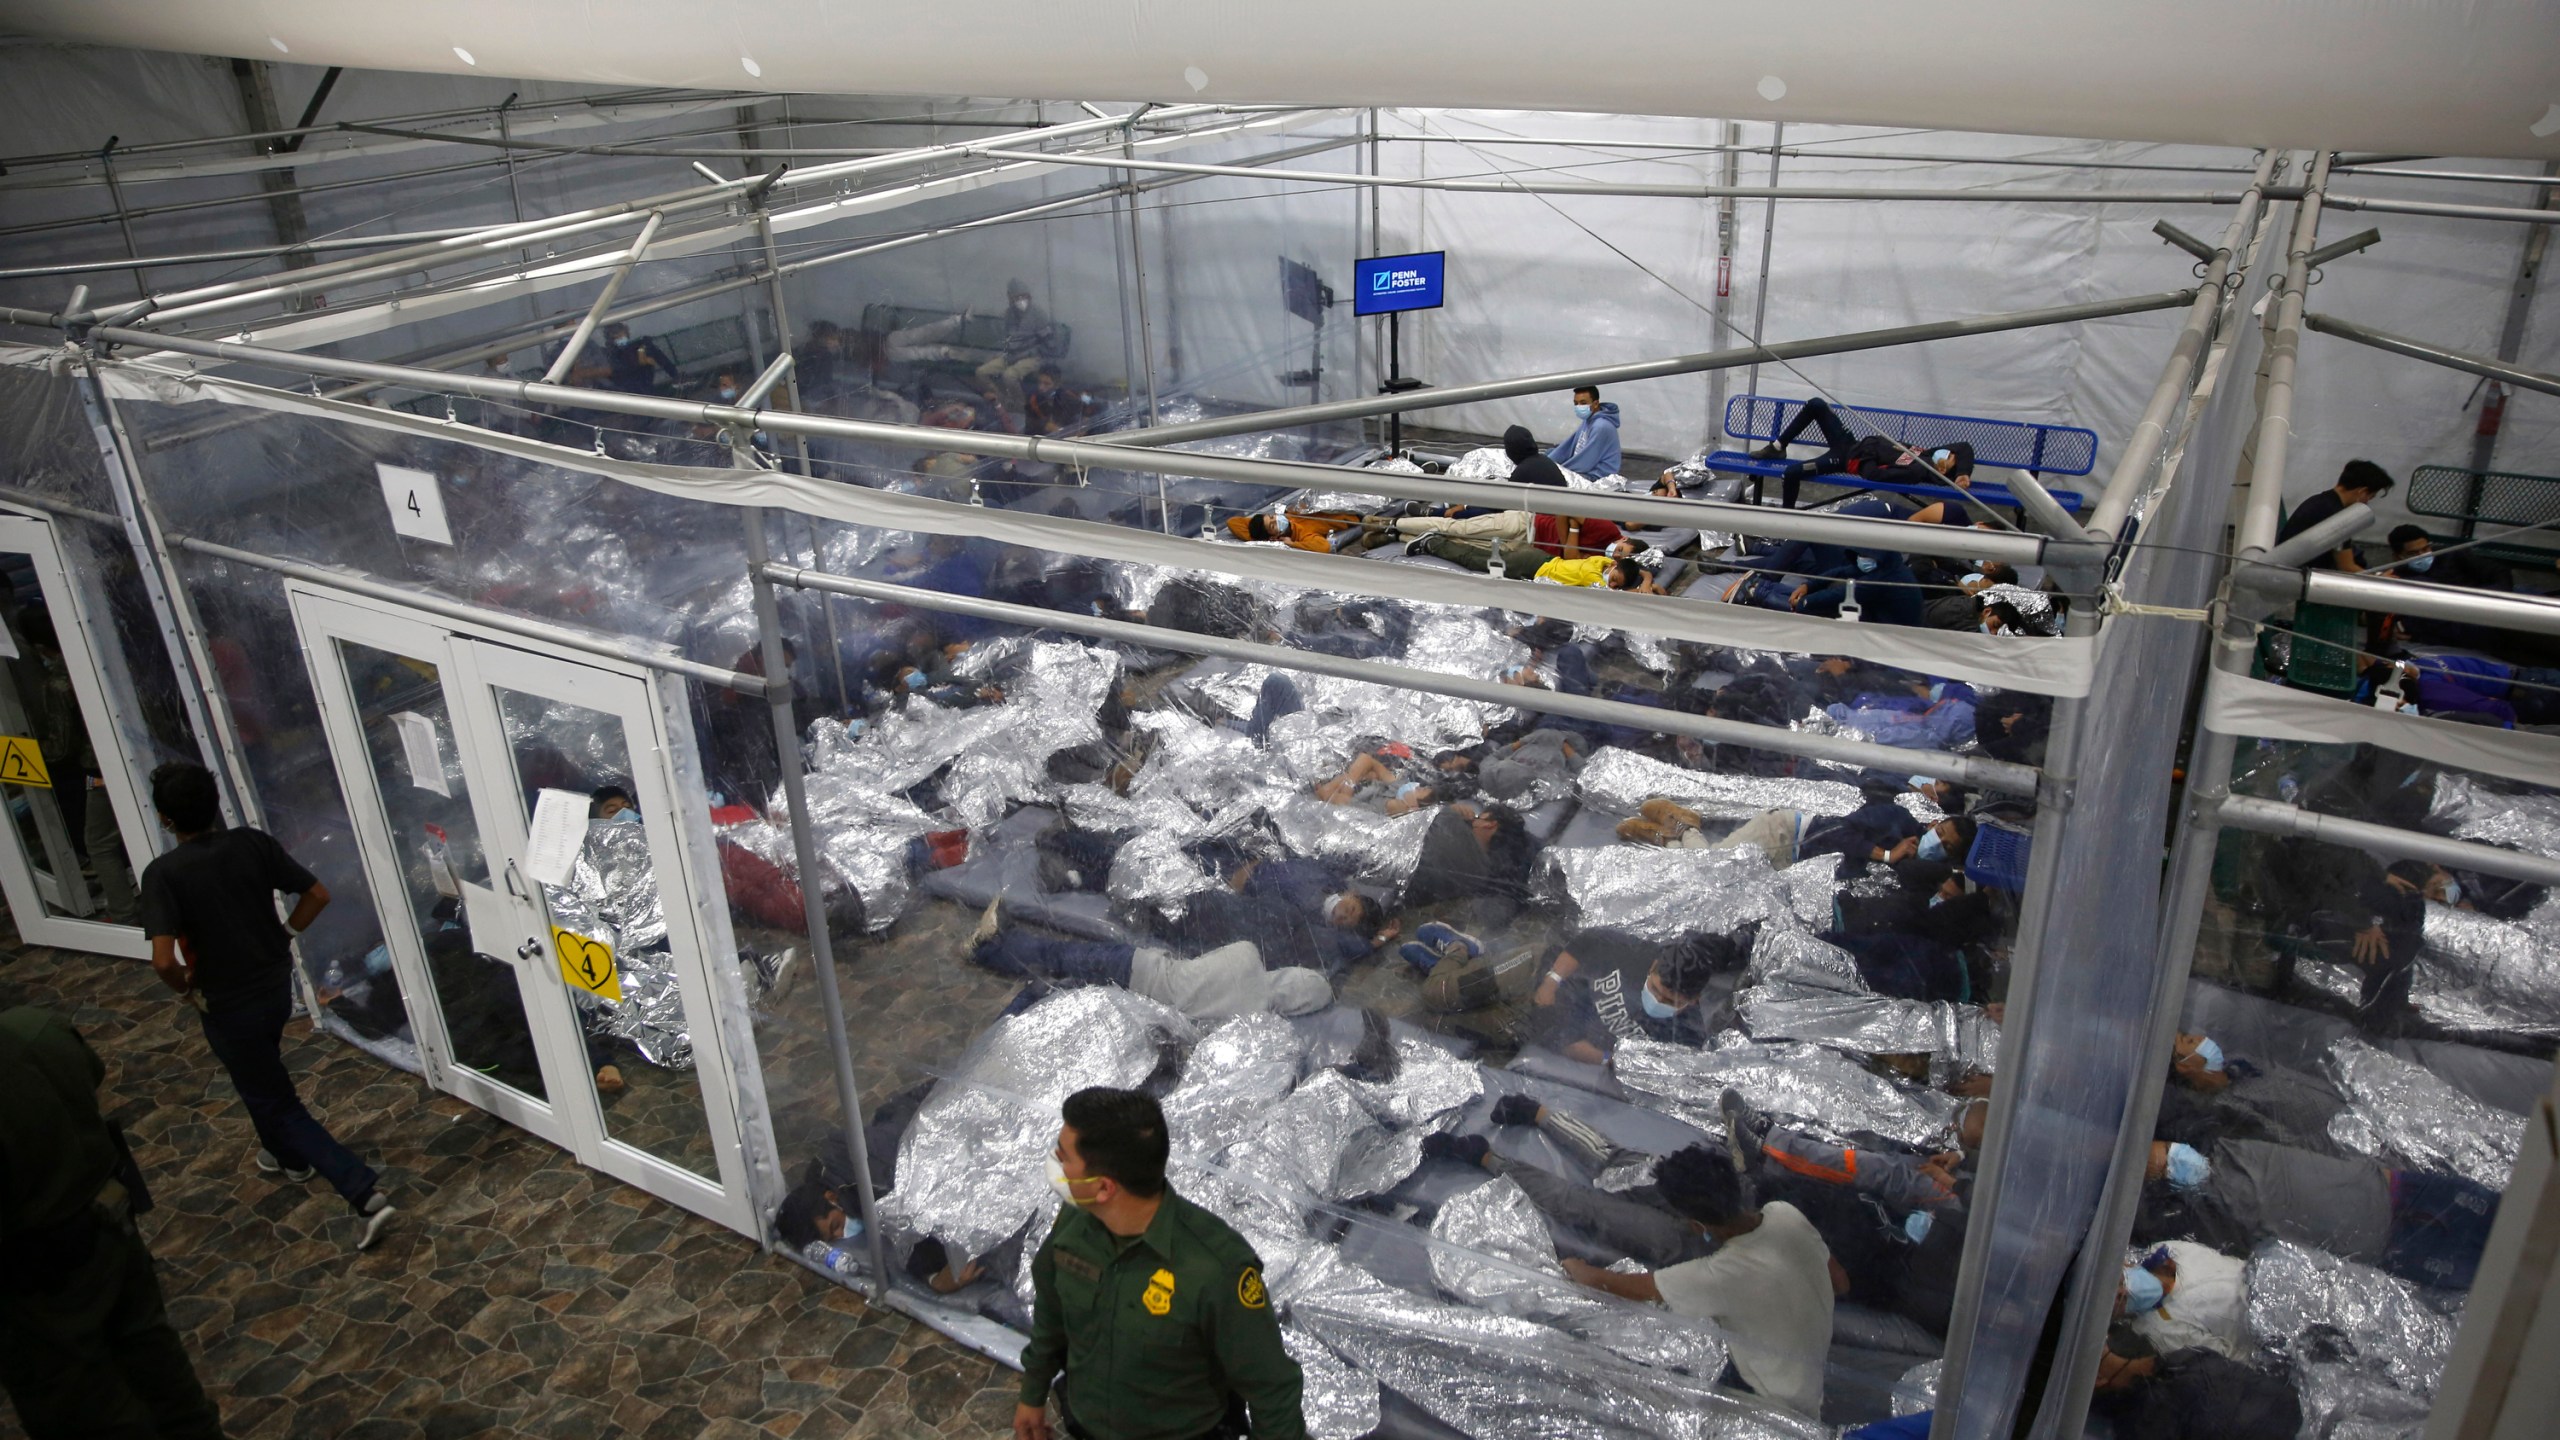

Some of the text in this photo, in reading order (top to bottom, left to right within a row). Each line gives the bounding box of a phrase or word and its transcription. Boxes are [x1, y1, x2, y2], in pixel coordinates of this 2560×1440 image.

[1392, 270, 1417, 280] PENN
[1392, 277, 1426, 288] FOSTER
[408, 490, 421, 517] 4
[11, 754, 28, 777] 2
[582, 954, 596, 981] 4
